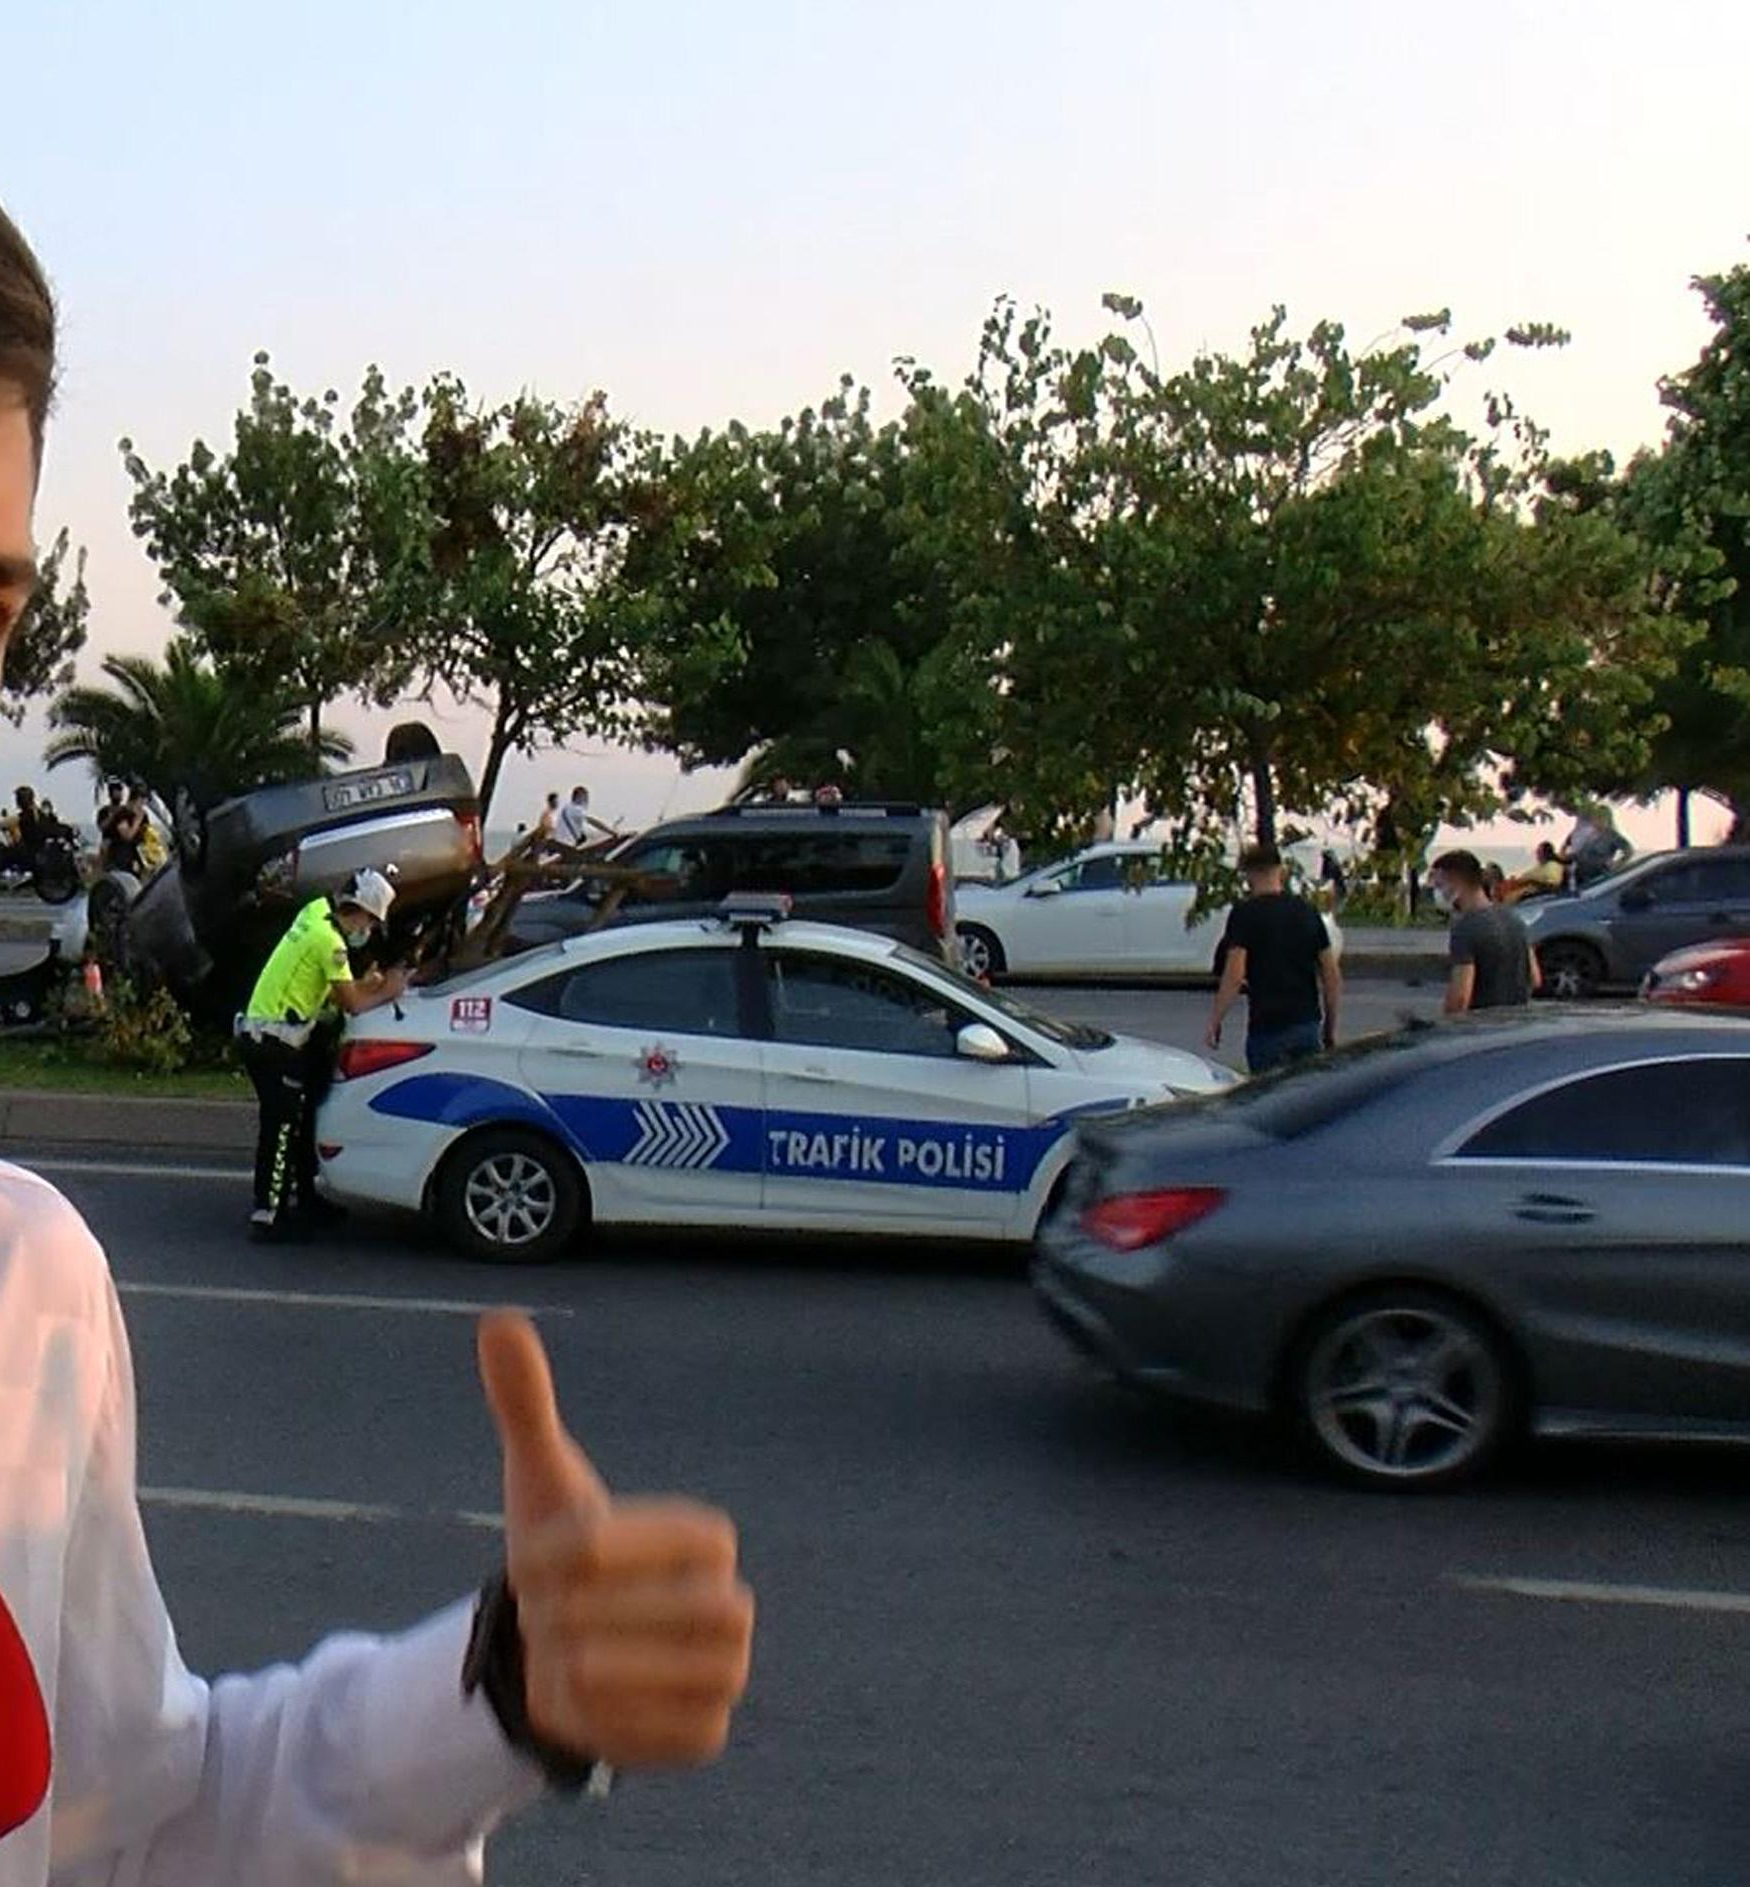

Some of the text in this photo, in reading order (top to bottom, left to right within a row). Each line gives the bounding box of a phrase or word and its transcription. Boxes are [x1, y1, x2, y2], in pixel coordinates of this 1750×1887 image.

[459, 1001, 486, 1017] 112
[768, 1125, 1005, 1181] TRAFİK POLİSİ
